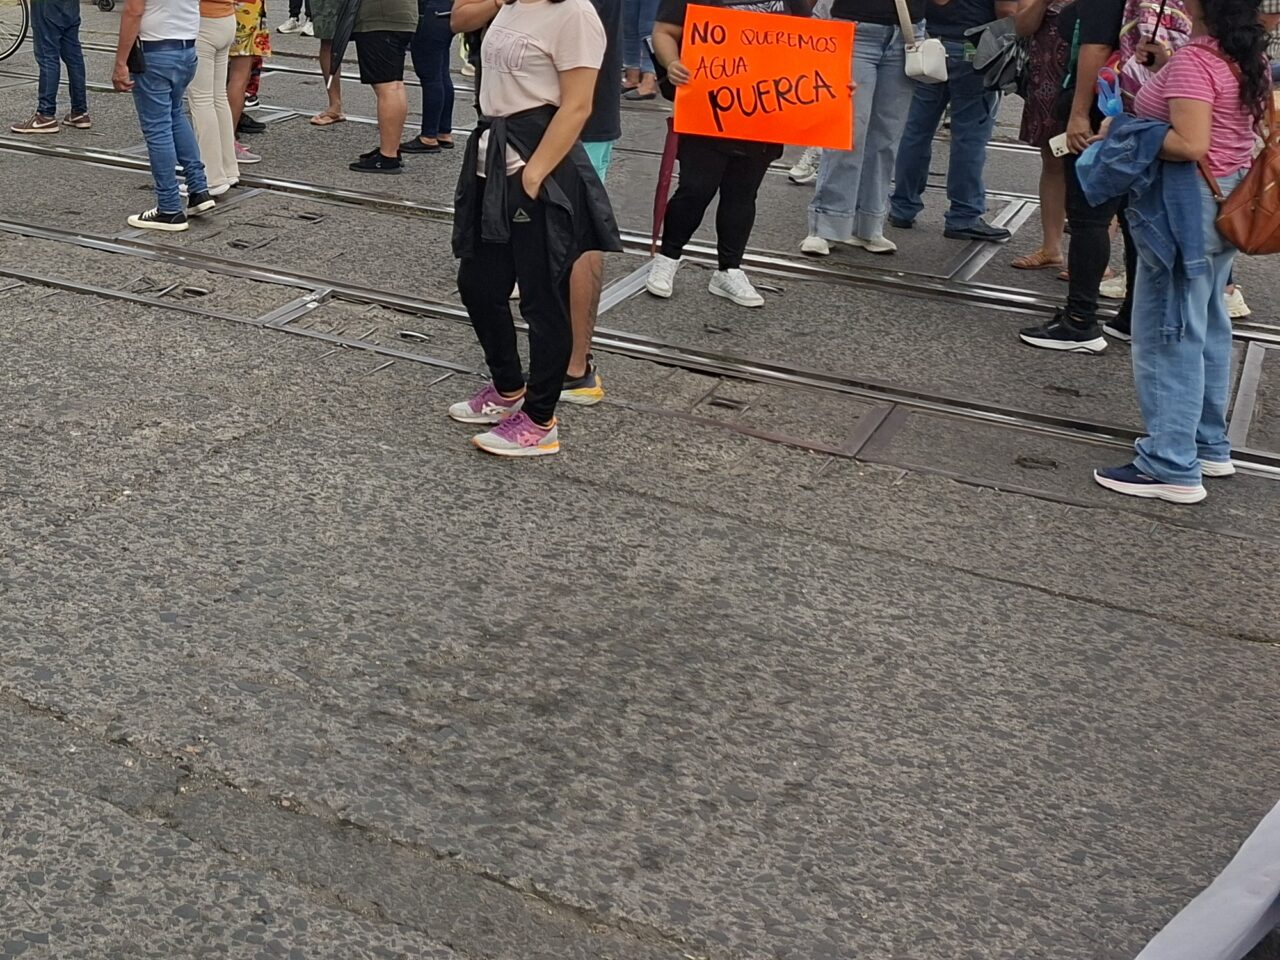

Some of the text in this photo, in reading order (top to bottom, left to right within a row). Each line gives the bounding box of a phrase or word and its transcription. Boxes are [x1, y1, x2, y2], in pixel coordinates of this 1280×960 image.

[691, 21, 838, 53] NO QUEREMOS
[694, 56, 748, 80] AGUA
[707, 70, 837, 132] PUERCA
